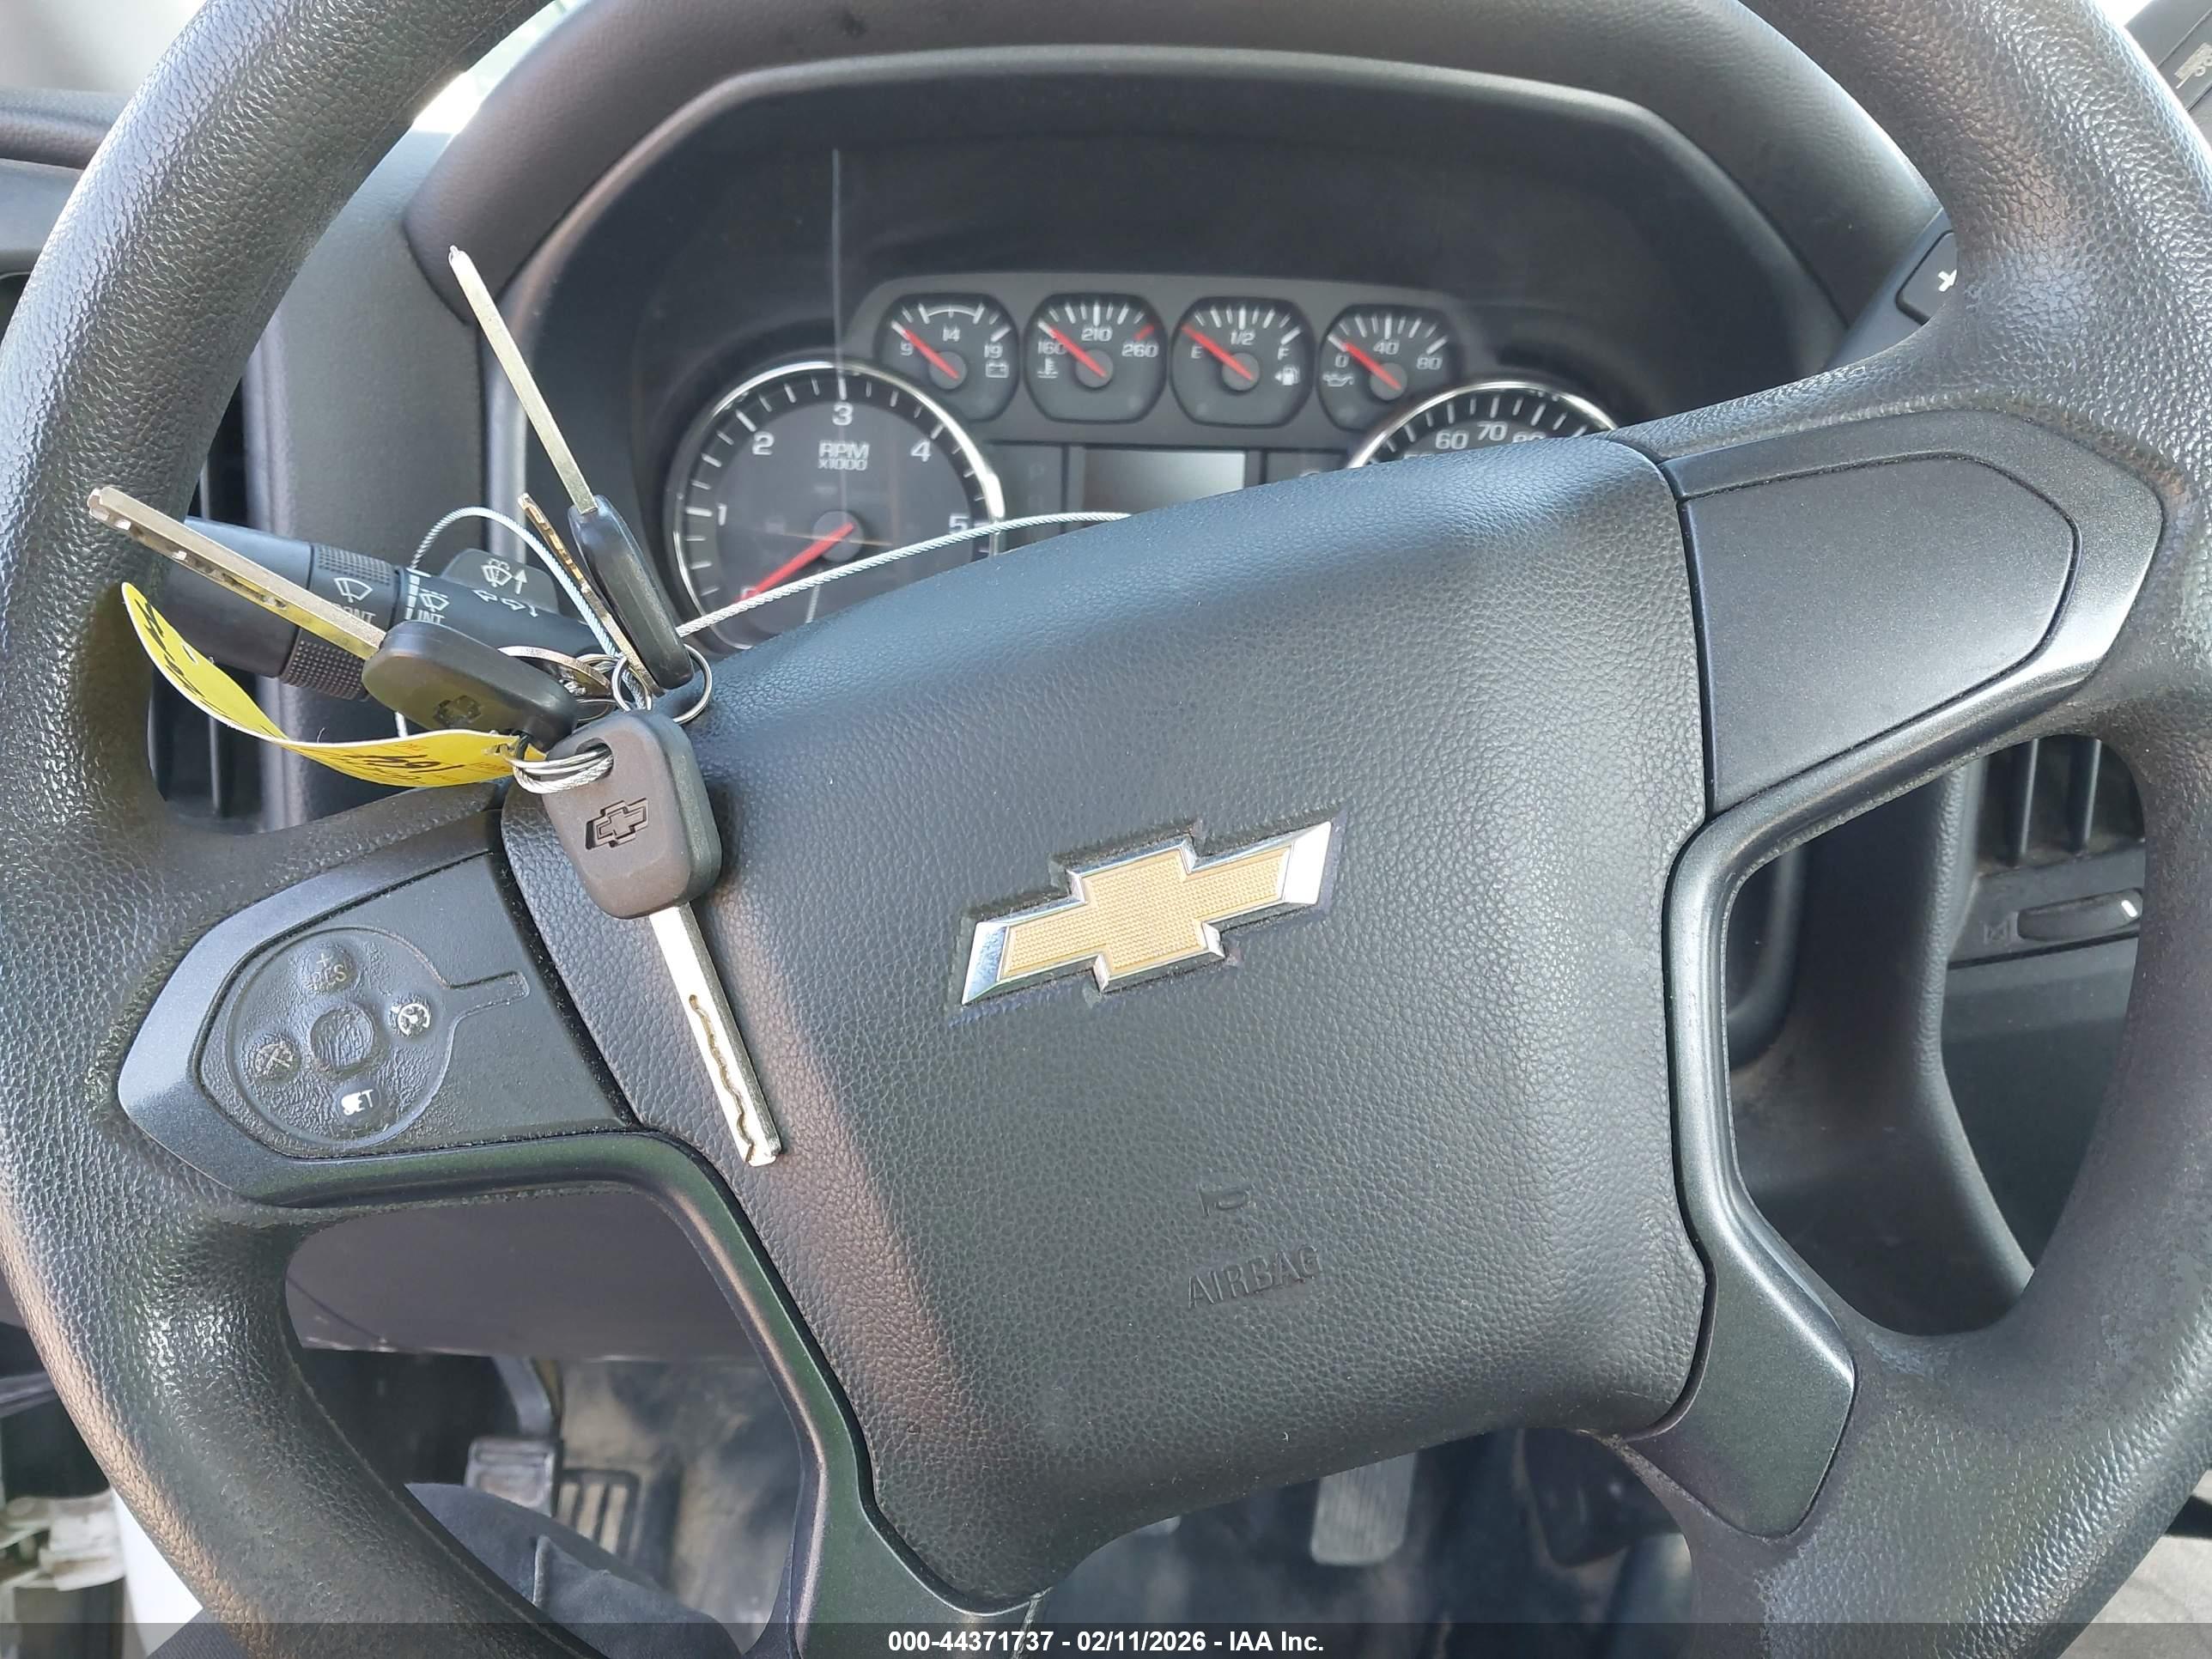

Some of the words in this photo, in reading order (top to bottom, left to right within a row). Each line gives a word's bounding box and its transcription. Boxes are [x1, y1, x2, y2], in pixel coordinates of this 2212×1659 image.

[943, 328, 961, 342] 14
[1081, 329, 1112, 342] 210
[1230, 331, 1255, 344] 1/2
[900, 343, 914, 356] 9
[984, 345, 1003, 358] 19
[1037, 341, 1067, 355] 160
[1122, 344, 1158, 357] 260
[1191, 346, 1202, 359] E
[1277, 348, 1290, 360] F
[1374, 340, 1400, 355] 40
[1334, 355, 1349, 368] 0
[1416, 357, 1443, 370] 80
[831, 404, 853, 426] 3
[1476, 421, 1509, 441] 70
[752, 432, 774, 456] 2
[1435, 432, 1468, 450] 60
[818, 440, 870, 459] RPM
[910, 440, 932, 462] 4
[718, 503, 727, 526] 1
[948, 513, 970, 534] 5
[1187, 1245, 1323, 1310] AIRBAG
